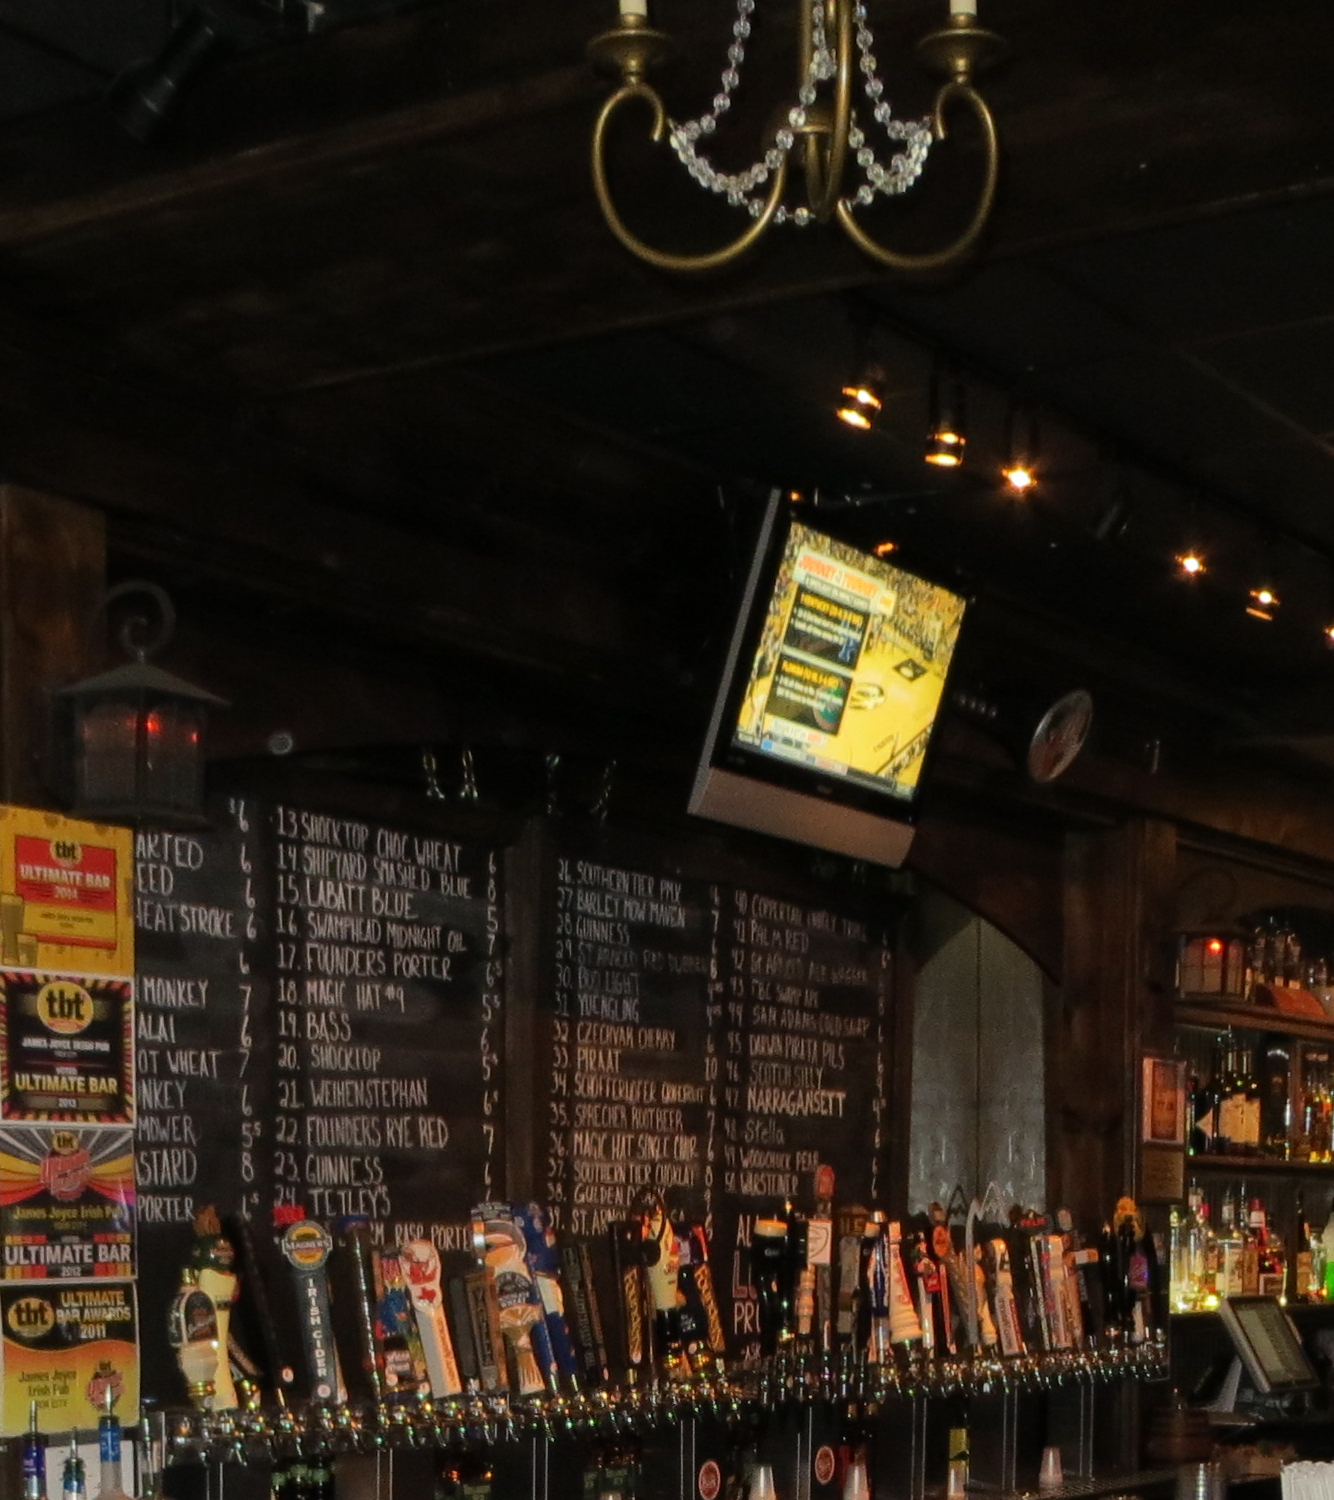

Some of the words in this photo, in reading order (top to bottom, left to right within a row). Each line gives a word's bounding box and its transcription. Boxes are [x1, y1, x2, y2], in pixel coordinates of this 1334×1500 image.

[414, 838, 463, 873] WHEAT
[19, 863, 84, 886] ULTIMATE
[86, 872, 111, 888] BAR
[302, 845, 367, 883] SHIPYARD
[373, 855, 431, 893] SMASHED
[440, 873, 472, 900] BLUE
[306, 876, 366, 914] LABATT
[371, 886, 418, 920] BLUE
[180, 904, 237, 940] STROKE
[306, 911, 381, 945] SWAMPHEAD
[385, 921, 443, 951] MIDNIGHT
[447, 932, 467, 953] OIL
[576, 915, 630, 945] GUINNESS
[306, 942, 386, 977] FOUNDERS
[393, 952, 452, 983] PORTER
[46, 989, 85, 1021] tbt
[143, 977, 209, 1009] MONKEY
[306, 979, 346, 1007] MAGIC
[356, 983, 381, 1011] HAT
[384, 984, 405, 1013] #9
[577, 992, 641, 1024] YUENGLING
[138, 1011, 176, 1044] ALAI
[306, 1011, 352, 1044] BASS
[167, 1050, 223, 1079] WHEAT
[577, 1047, 622, 1074] PIRAAT
[750, 1061, 792, 1087] SCOTCH
[14, 1072, 86, 1093] ULTIMATE
[89, 1076, 118, 1095] BAR
[310, 1078, 429, 1109] WEIHENSTEPHAN
[747, 1086, 847, 1119] NARRAGANSETT
[306, 1115, 381, 1148] FOUNDERS
[386, 1115, 411, 1149] RYE
[419, 1115, 450, 1149] RED
[573, 1130, 606, 1159] MAGIC
[612, 1132, 635, 1160] HAT
[745, 1118, 786, 1146] Stella
[305, 1153, 384, 1187] GUINNESS
[137, 1195, 196, 1223] PORTER
[573, 1182, 624, 1206] GULDEN
[49, 1207, 78, 1223] Joyce
[4, 1243, 94, 1266] ULTIMATE
[98, 1243, 131, 1263] BAR
[285, 1239, 331, 1251] MAGNERS
[60, 1290, 126, 1307] ULTIMATE
[306, 1277, 322, 1326] IRISH
[15, 1302, 49, 1326] tbt
[56, 1308, 81, 1323] BAR
[83, 1306, 132, 1322] AWARDS
[80, 1322, 107, 1339] 2011
[312, 1330, 328, 1377] CIDER
[19, 1370, 49, 1383] James
[51, 1369, 77, 1386] Joyce
[28, 1385, 50, 1398] Irish
[52, 1384, 70, 1396] Pub
